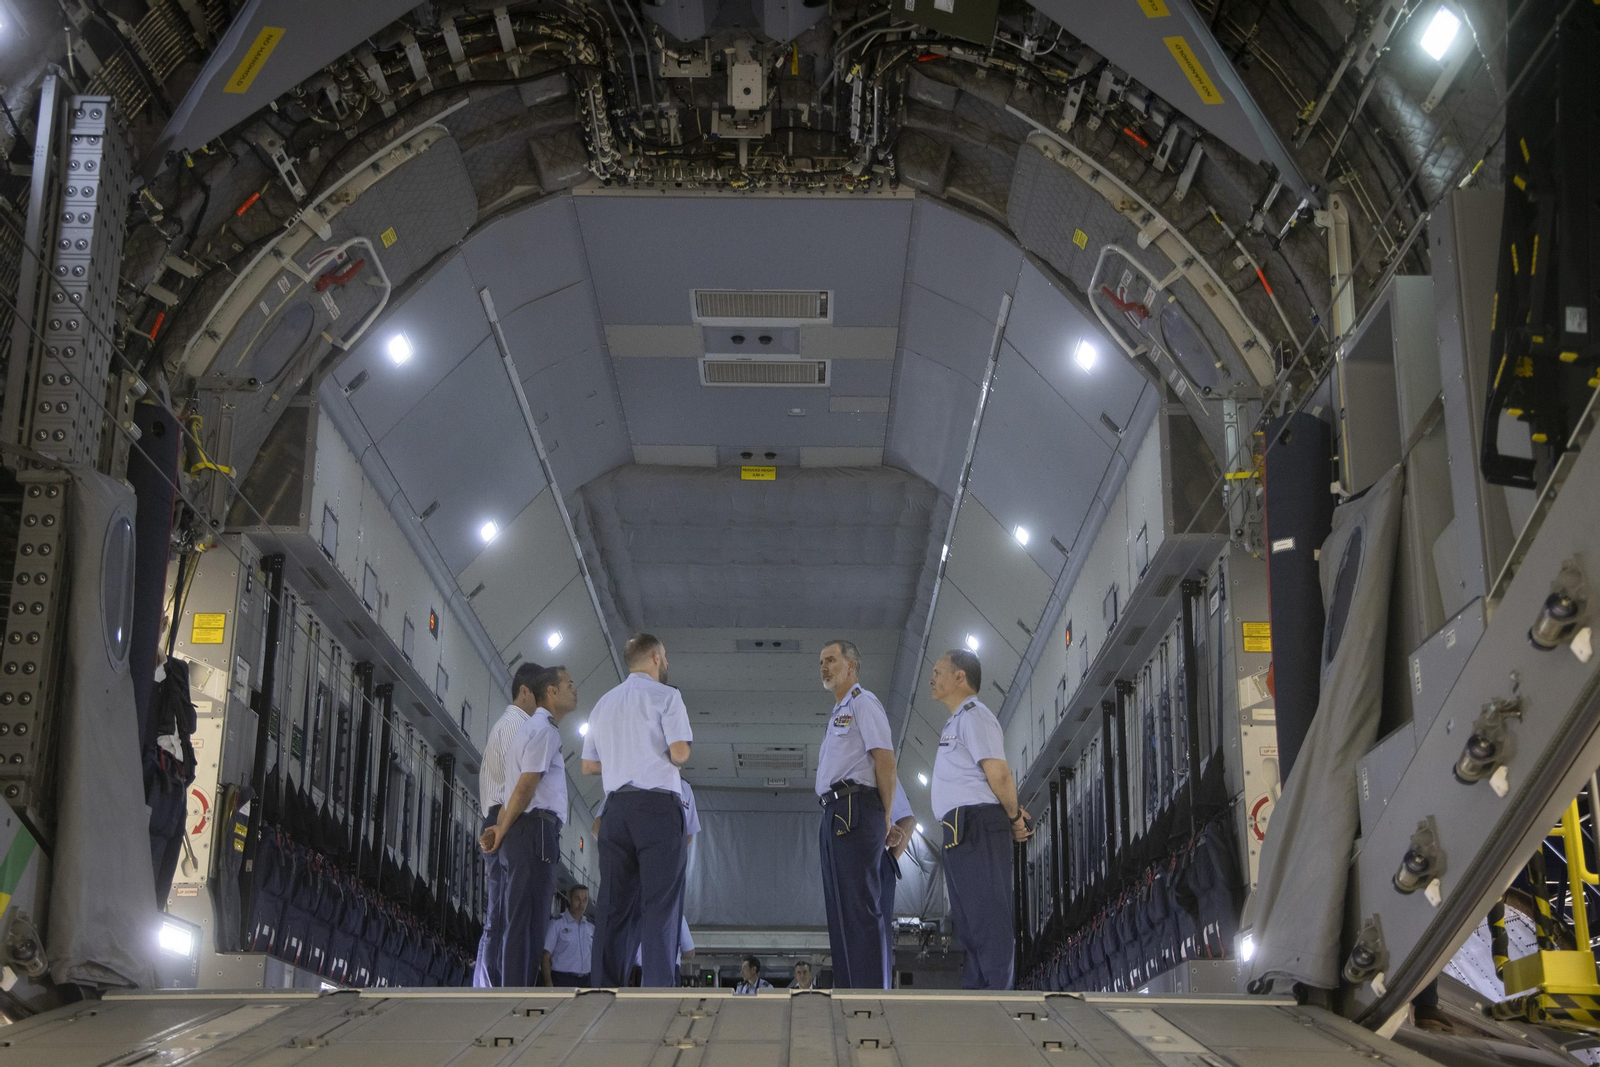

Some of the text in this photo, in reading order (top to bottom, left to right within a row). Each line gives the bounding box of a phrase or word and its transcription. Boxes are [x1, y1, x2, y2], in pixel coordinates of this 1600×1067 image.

[236, 34, 273, 87] NO HANDHOLD
[1175, 44, 1212, 97] NO HANDHOLD
